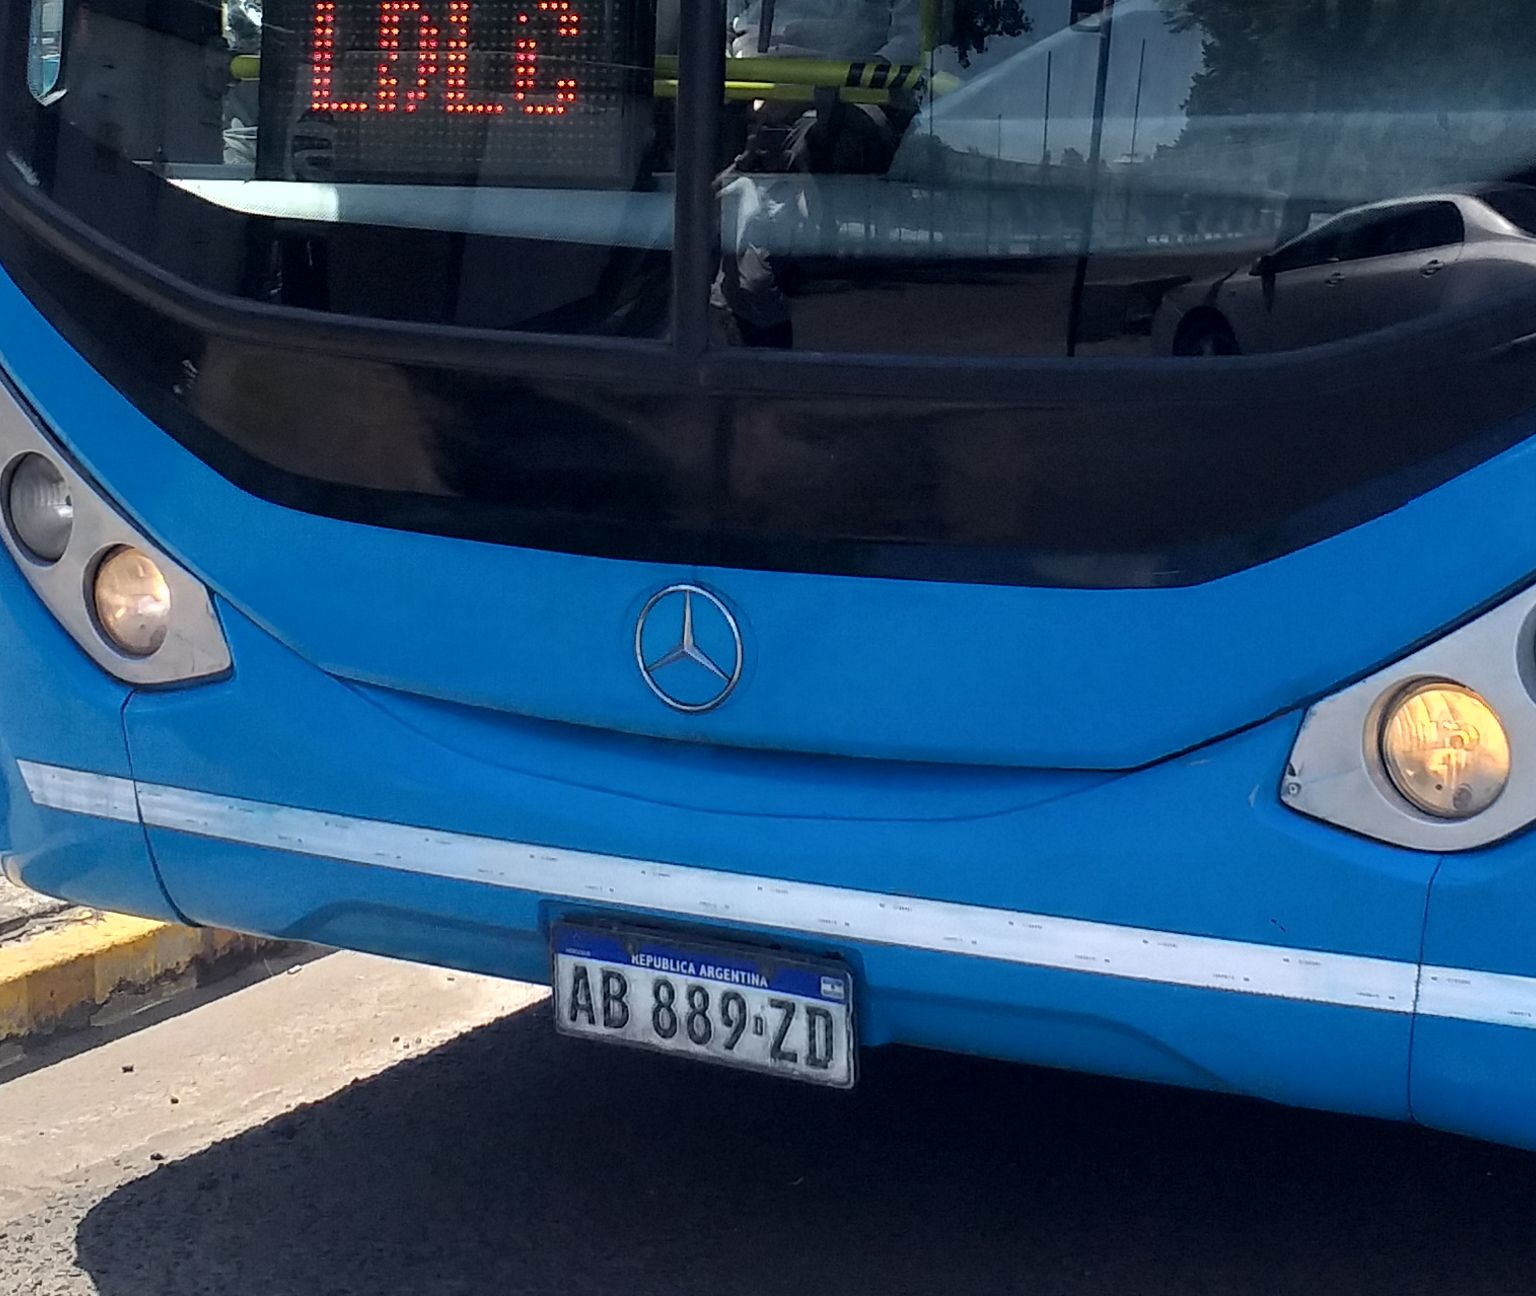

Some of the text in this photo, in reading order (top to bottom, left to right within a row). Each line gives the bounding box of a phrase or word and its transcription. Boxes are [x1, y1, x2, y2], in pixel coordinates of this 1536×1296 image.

[631, 952, 768, 989] REPUBLICA ARGENTINA
[569, 965, 630, 1029] AB
[651, 977, 748, 1051] 889
[766, 997, 834, 1070] ZD
